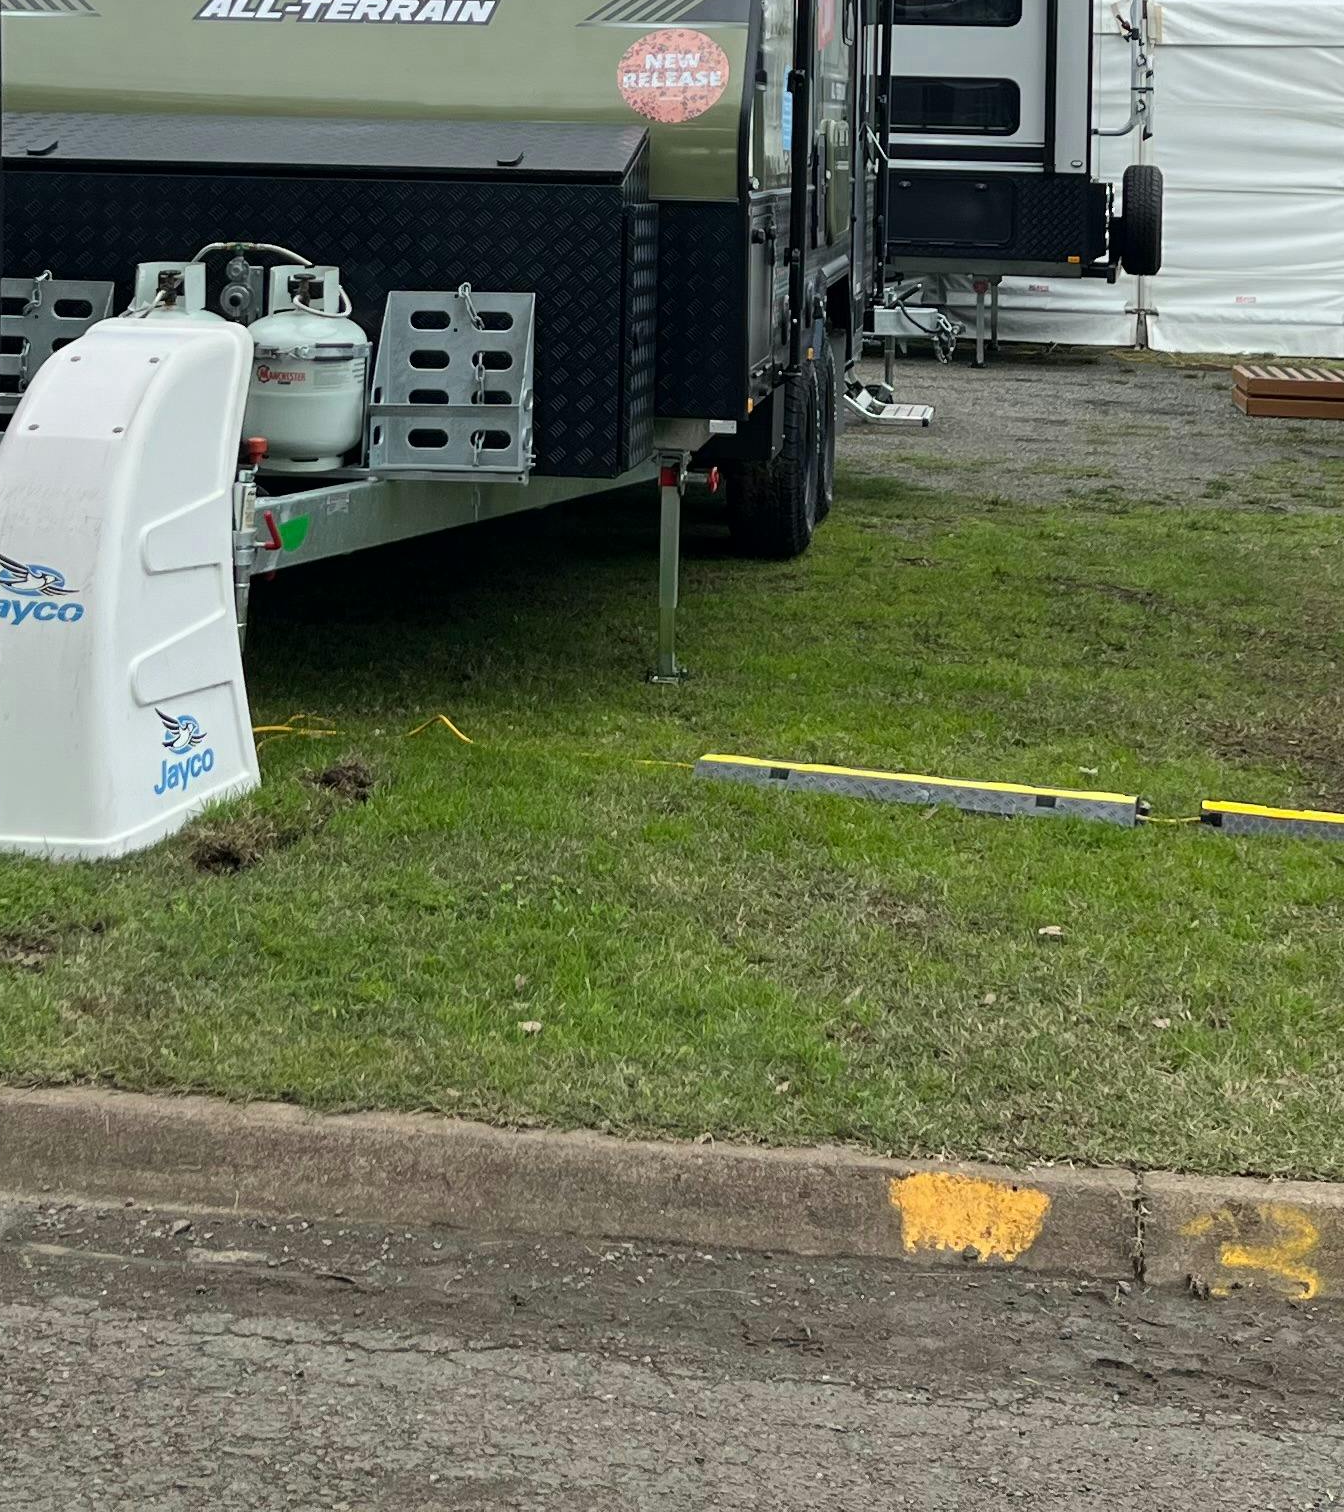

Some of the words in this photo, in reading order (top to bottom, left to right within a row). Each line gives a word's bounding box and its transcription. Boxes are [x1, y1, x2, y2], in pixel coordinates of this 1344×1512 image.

[645, 53, 701, 69] NEW
[622, 70, 722, 89] RELEASE
[154, 747, 215, 796] Jayco
